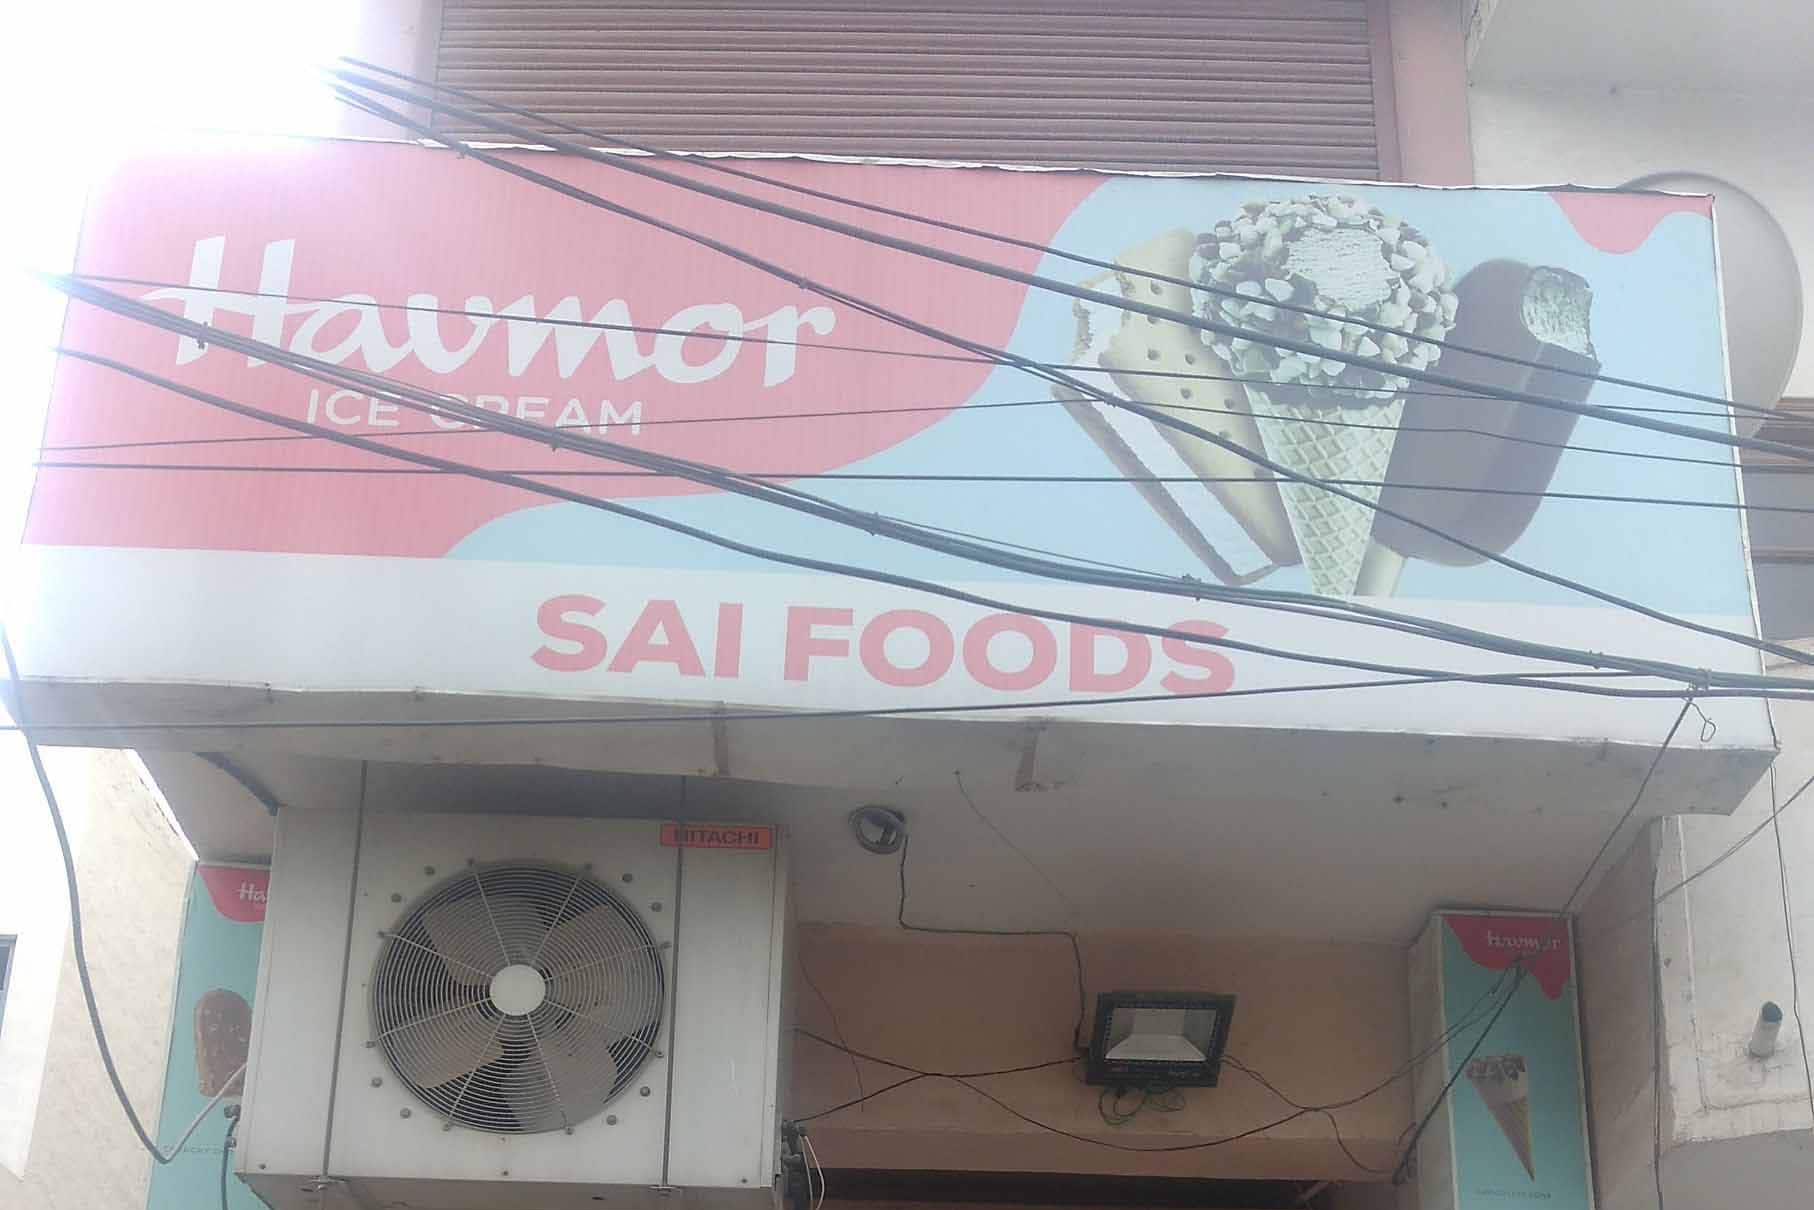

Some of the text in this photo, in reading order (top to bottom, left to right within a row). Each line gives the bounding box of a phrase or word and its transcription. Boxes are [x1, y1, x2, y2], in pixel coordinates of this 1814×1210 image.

[138, 236, 835, 387] Havmor
[307, 388, 642, 435] ICE CREAM
[530, 594, 1236, 695] SAI FOODS
[673, 829, 760, 846] HITACHI
